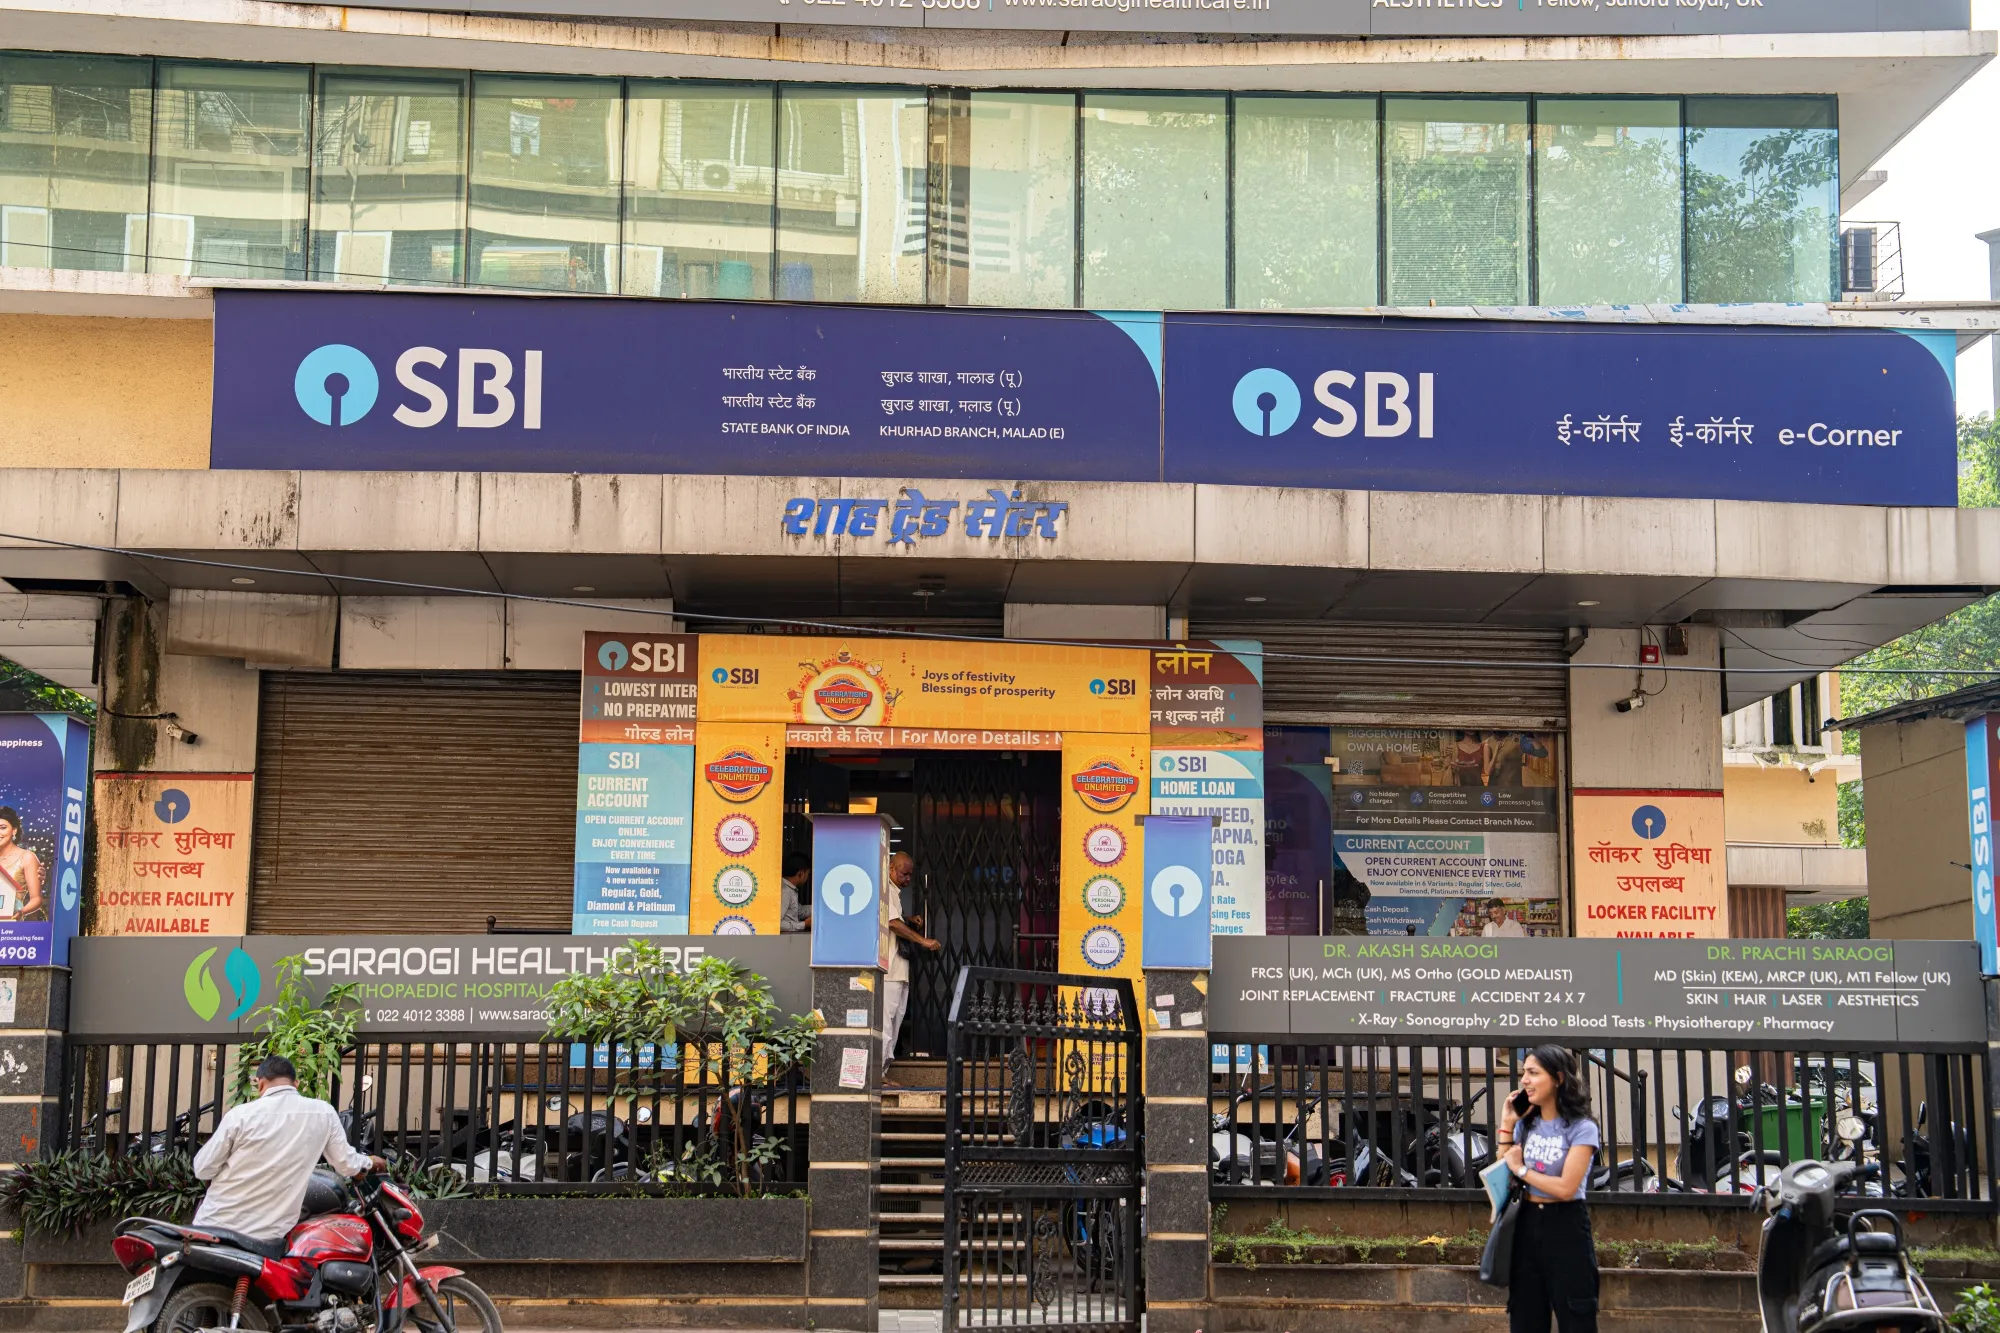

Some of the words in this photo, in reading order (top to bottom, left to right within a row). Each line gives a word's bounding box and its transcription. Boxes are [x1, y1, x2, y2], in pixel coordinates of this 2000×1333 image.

[722, 366, 764, 381] भारतीय
[768, 366, 793, 381] स्टेट
[881, 370, 914, 385] खुराड
[918, 371, 952, 386] शाखा,
[957, 371, 995, 385] मालाड
[393, 346, 542, 429] SBI
[722, 394, 764, 409] भारतीय
[768, 394, 793, 410] स्टेट
[797, 393, 816, 410] बैंक
[881, 399, 914, 413] खुराड
[918, 399, 953, 414] शाखा,
[959, 400, 993, 413] मलाड
[1312, 370, 1434, 438] SBI
[722, 423, 758, 434] STATE
[761, 423, 795, 434] BANK
[796, 424, 813, 435] OF
[816, 424, 850, 436] INDIA
[880, 426, 942, 437] KHURHAD
[944, 427, 1000, 440] BRANCH,
[1002, 428, 1047, 438] MALAD
[1049, 428, 1065, 440] (E)
[1557, 414, 1641, 446] ई-कॉर्नर
[1669, 416, 1754, 447] ई-कॉर्नर
[1778, 422, 1903, 446] e-Corner
[782, 497, 889, 537] शाह
[888, 488, 959, 545] ट्रेड
[965, 489, 1069, 538] सेंटर
[631, 641, 685, 673] SBI
[1155, 644, 1213, 675] लोन
[730, 667, 759, 684] SBI
[921, 670, 949, 682] Joys
[952, 671, 964, 681] of
[966, 672, 1016, 685] festivity
[604, 682, 656, 698] LOWEST
[660, 683, 697, 698] INTER
[921, 683, 977, 697] Blessings
[979, 684, 993, 695] of
[994, 687, 1056, 699] prosperity
[1107, 679, 1136, 695] SBI
[1156, 685, 1182, 701] लोन
[1186, 686, 1225, 701] अवधि
[603, 702, 623, 717] NO
[627, 703, 696, 718] PREPAYME
[1165, 710, 1198, 726] शुल्क
[1201, 707, 1225, 724] नहीं
[625, 724, 661, 741] गोल्ड
[665, 725, 694, 741] लोन
[837, 727, 850, 743] के
[855, 728, 884, 744] लिए
[901, 730, 929, 744] For
[933, 731, 977, 745] More
[982, 731, 1040, 746] Details
[608, 751, 640, 769] SBI
[1178, 756, 1207, 772] SBI
[588, 776, 648, 791] CURRENT
[1160, 781, 1198, 795] HOME
[1201, 781, 1235, 795] LOAN
[587, 793, 649, 808] ACCOUNT
[63, 787, 83, 865] SBI
[608, 815, 645, 825] CURRENT
[647, 816, 684, 826] ACCOUNT
[1356, 816, 1370, 824] For
[1393, 817, 1421, 825] Details
[1483, 818, 1512, 826] Branch
[1972, 786, 1989, 866] SBI
[106, 826, 162, 848] लॉकर
[174, 827, 235, 855] सुविधा
[620, 839, 675, 849] CONVENIENCE
[1346, 838, 1405, 850] CURRENT
[1407, 839, 1471, 851] ACCOUNT
[1365, 857, 1392, 866] OPEN
[1393, 857, 1437, 866] CURRENT
[1439, 858, 1487, 867] ACCOUNT
[1588, 841, 1642, 863] लॉकर
[1653, 843, 1712, 870] सुविधा
[133, 862, 204, 878] उपलब्ध
[1367, 868, 1399, 877] ENJOY
[1400, 869, 1471, 878] CONVENIENCE
[1472, 869, 1502, 878] EVERY
[1617, 876, 1685, 892] उपलब्ध
[100, 892, 161, 906] LOCKER
[166, 892, 234, 906] FACILITY
[587, 901, 625, 911] Diamond
[637, 902, 675, 912] Platinum
[1588, 905, 1646, 919] LOCKER
[1652, 906, 1716, 920] FACILITY
[125, 919, 209, 933] AVAILABLE
[0, 946, 37, 959] 4908
[1324, 944, 1351, 958] DR.
[1357, 944, 1414, 958] AKASH
[1420, 944, 1498, 958] SARAOGI
[1707, 947, 1735, 960] DR.
[1742, 947, 1806, 961] PRACHI
[1812, 947, 1894, 961] SARAOGI
[304, 947, 459, 975] SARAOGI
[1251, 968, 1283, 979] FRCS
[1289, 967, 1318, 981] (UK),
[1322, 968, 1352, 980] MCh
[1357, 968, 1387, 981] (UK),
[1391, 969, 1410, 980] MS
[1415, 968, 1452, 980] Ortho
[1457, 968, 1500, 982] (GOLD
[1505, 969, 1573, 982] MEDALIST)
[1654, 970, 1677, 981] MD
[1682, 970, 1716, 984] (Skin)
[1721, 970, 1763, 984] (KEM),
[1767, 971, 1806, 982] MRCP
[1810, 971, 1843, 985] (UK),
[1847, 972, 1870, 983] MTI
[1875, 971, 1918, 984] Fellow
[1923, 972, 1951, 986] (UK)
[464, 983, 543, 998] HOSPITAL
[1240, 990, 1279, 1001] JOINT
[1283, 990, 1374, 1002] REPLACEMENT
[1390, 991, 1455, 1002] FRACTURE
[1472, 992, 1540, 1003] ACCIDENT
[1544, 992, 1560, 1003] 24
[1565, 992, 1574, 1003] X
[1578, 992, 1585, 1003] 7
[1687, 993, 1718, 1005] SKIN
[1734, 994, 1767, 1005] HAIR
[1782, 994, 1822, 1006] LASER
[1837, 995, 1919, 1007] AESTHETICS
[377, 1010, 399, 1022] 022
[403, 1010, 432, 1022] 4012
[435, 1010, 465, 1022] 3388
[1358, 1014, 1397, 1028] X-Ray
[1406, 1014, 1490, 1029] Sonography
[1499, 1015, 1519, 1026] 2D
[1525, 1014, 1558, 1027] Echo
[1567, 1015, 1608, 1027] Blood
[1612, 1016, 1645, 1028] Tests
[1655, 1016, 1753, 1031] Physiotherapy
[1764, 1017, 1834, 1031] Pharmacy
